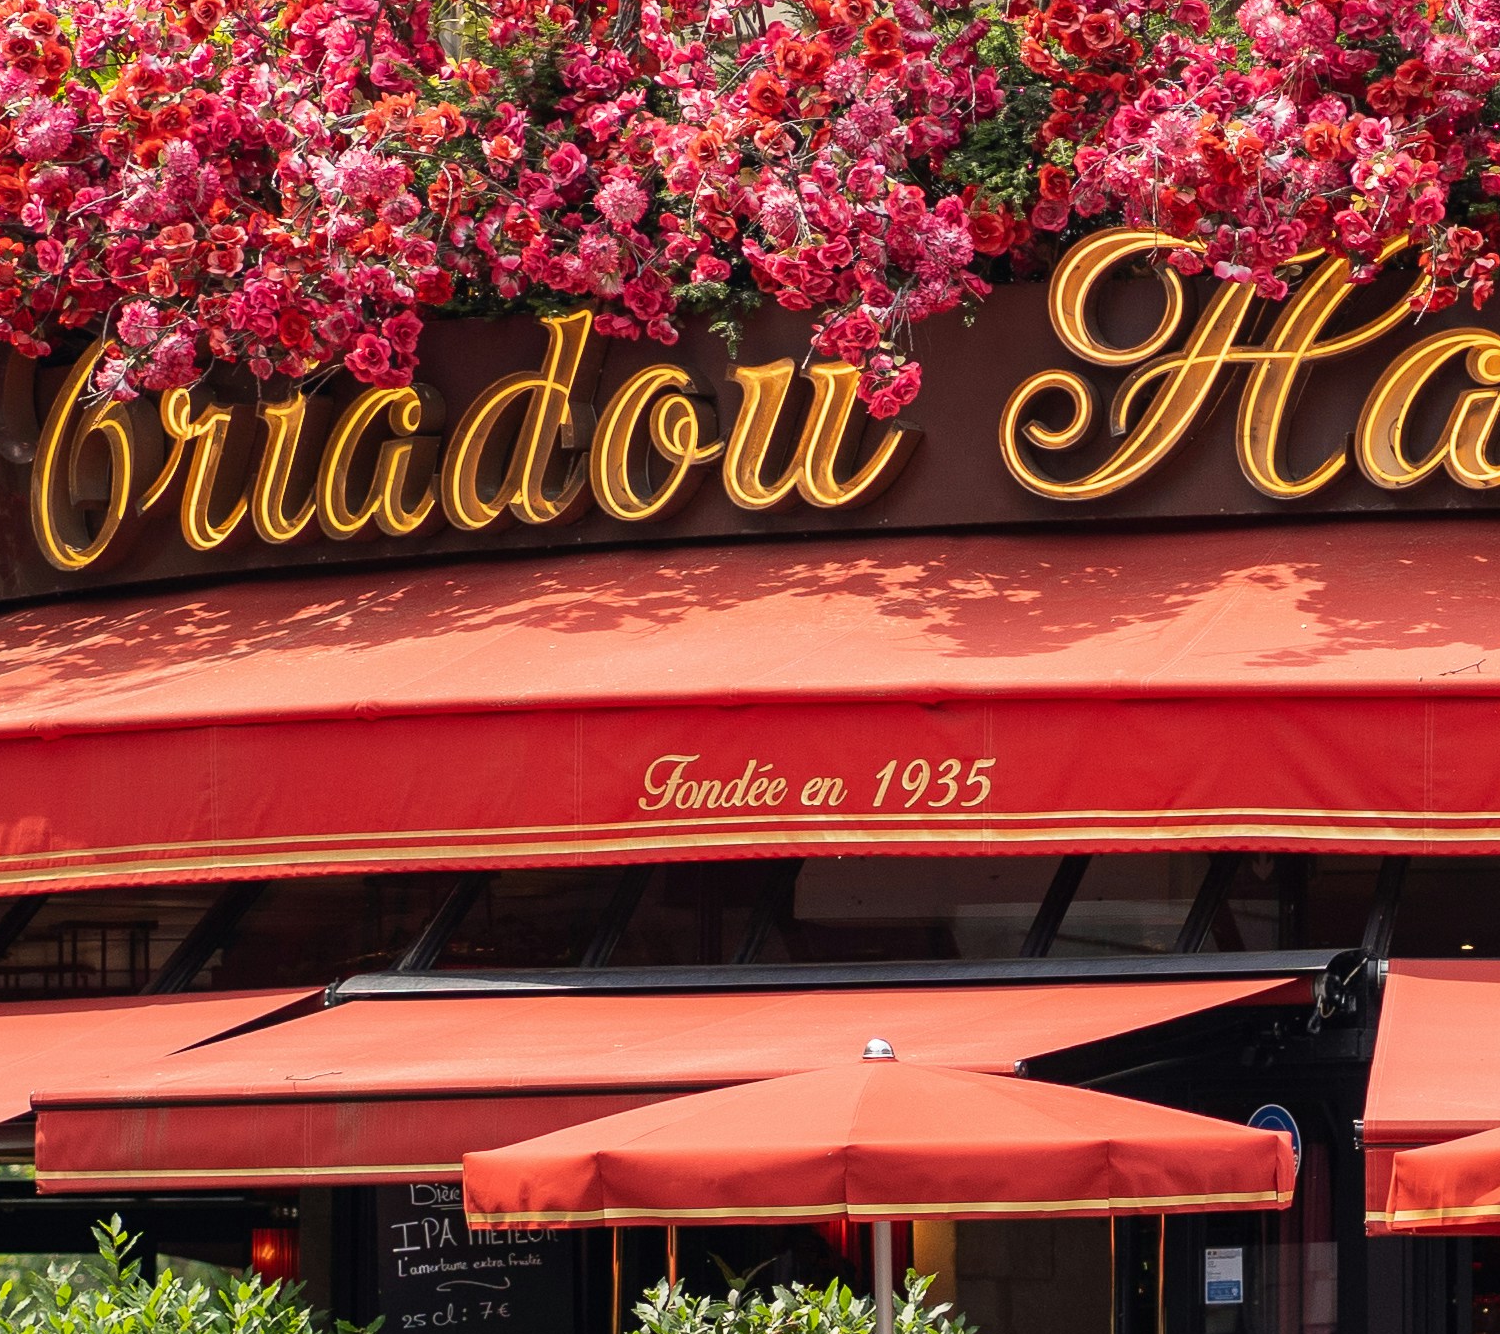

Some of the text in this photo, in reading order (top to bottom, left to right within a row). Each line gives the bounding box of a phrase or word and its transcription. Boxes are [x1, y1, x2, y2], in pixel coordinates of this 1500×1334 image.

[638, 753, 997, 812] Fondée en 1935
[390, 1217, 458, 1253] IPA
[397, 1256, 468, 1278] L'amertume
[473, 1256, 506, 1271] extra
[401, 1312, 427, 1330] 25
